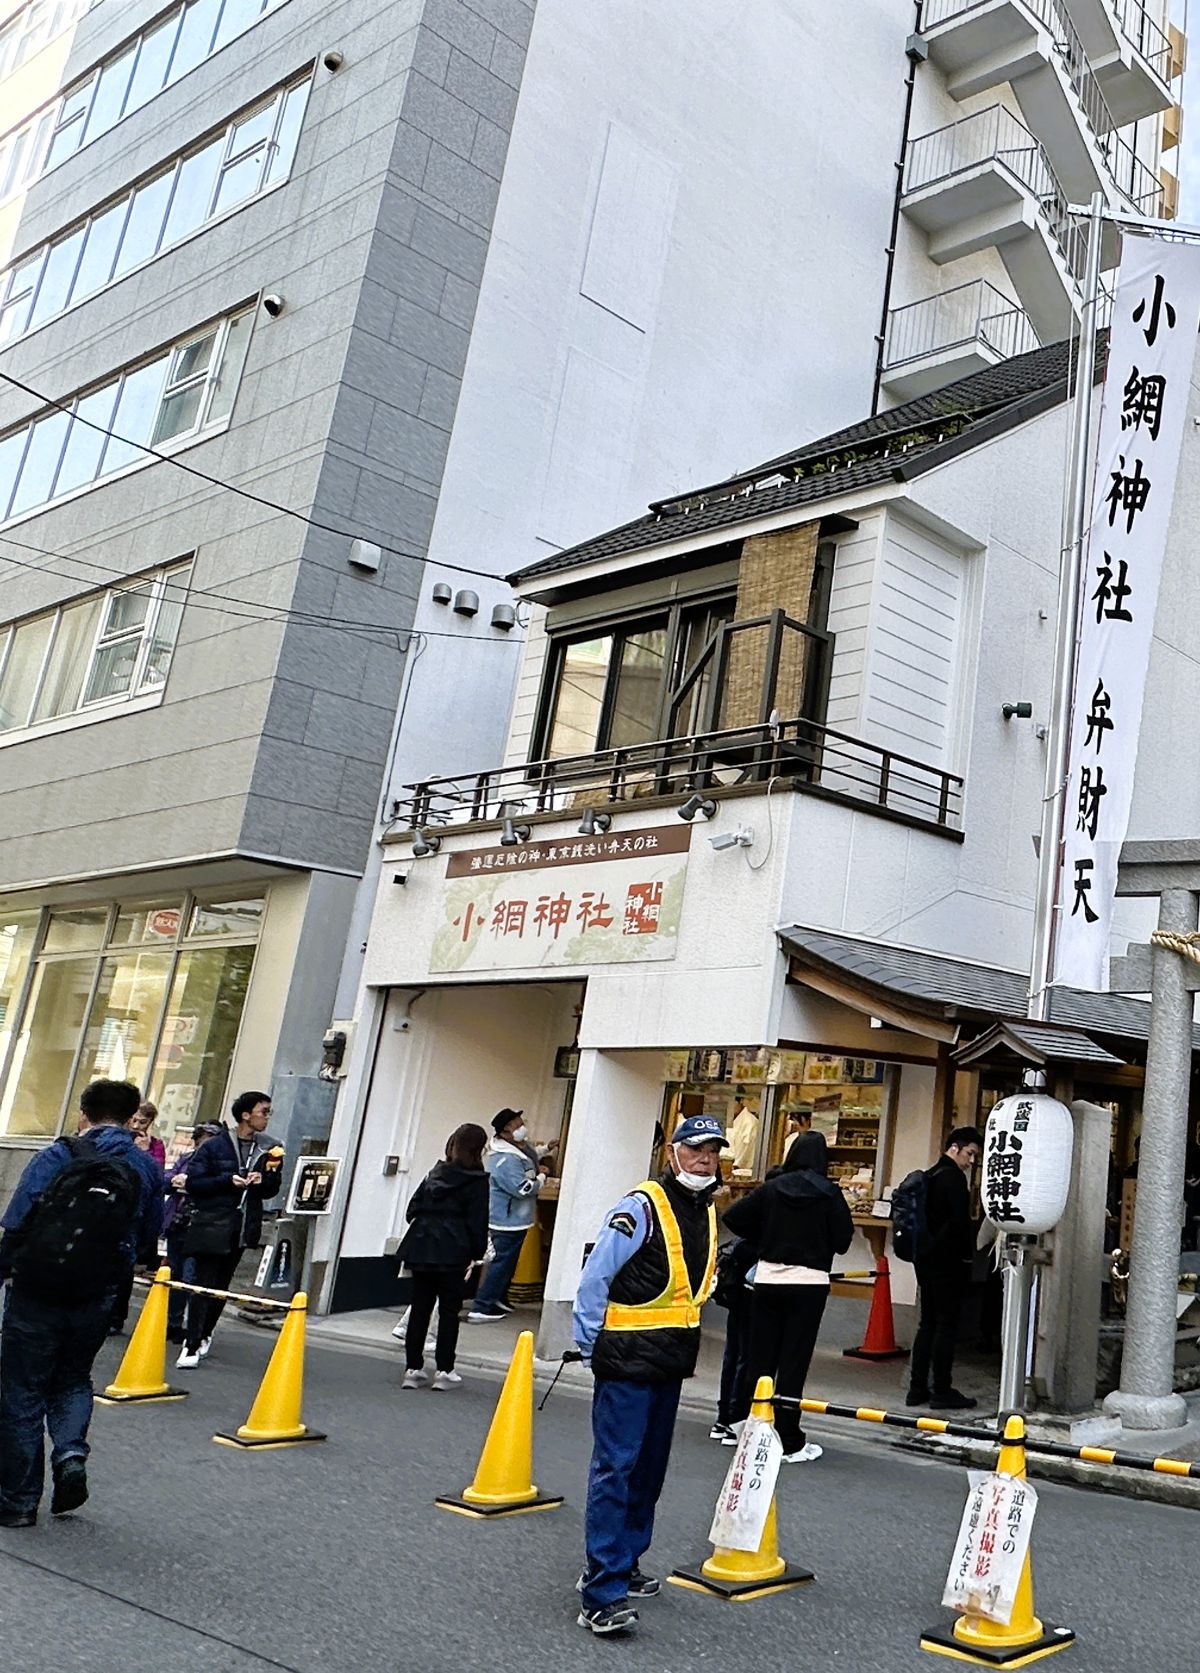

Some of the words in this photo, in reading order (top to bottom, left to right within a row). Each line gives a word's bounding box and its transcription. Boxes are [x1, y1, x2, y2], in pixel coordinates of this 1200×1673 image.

[1091, 275, 1176, 625] 小網神社
[1070, 679, 1114, 924] 弁財天
[452, 890, 616, 942] 小網神社
[986, 1130, 1026, 1224] 小網神社
[726, 1431, 754, 1512] 写真撮影
[749, 1433, 773, 1490] 道路での
[974, 1485, 1007, 1578] 写真撮影
[1002, 1489, 1026, 1554] 道路での
